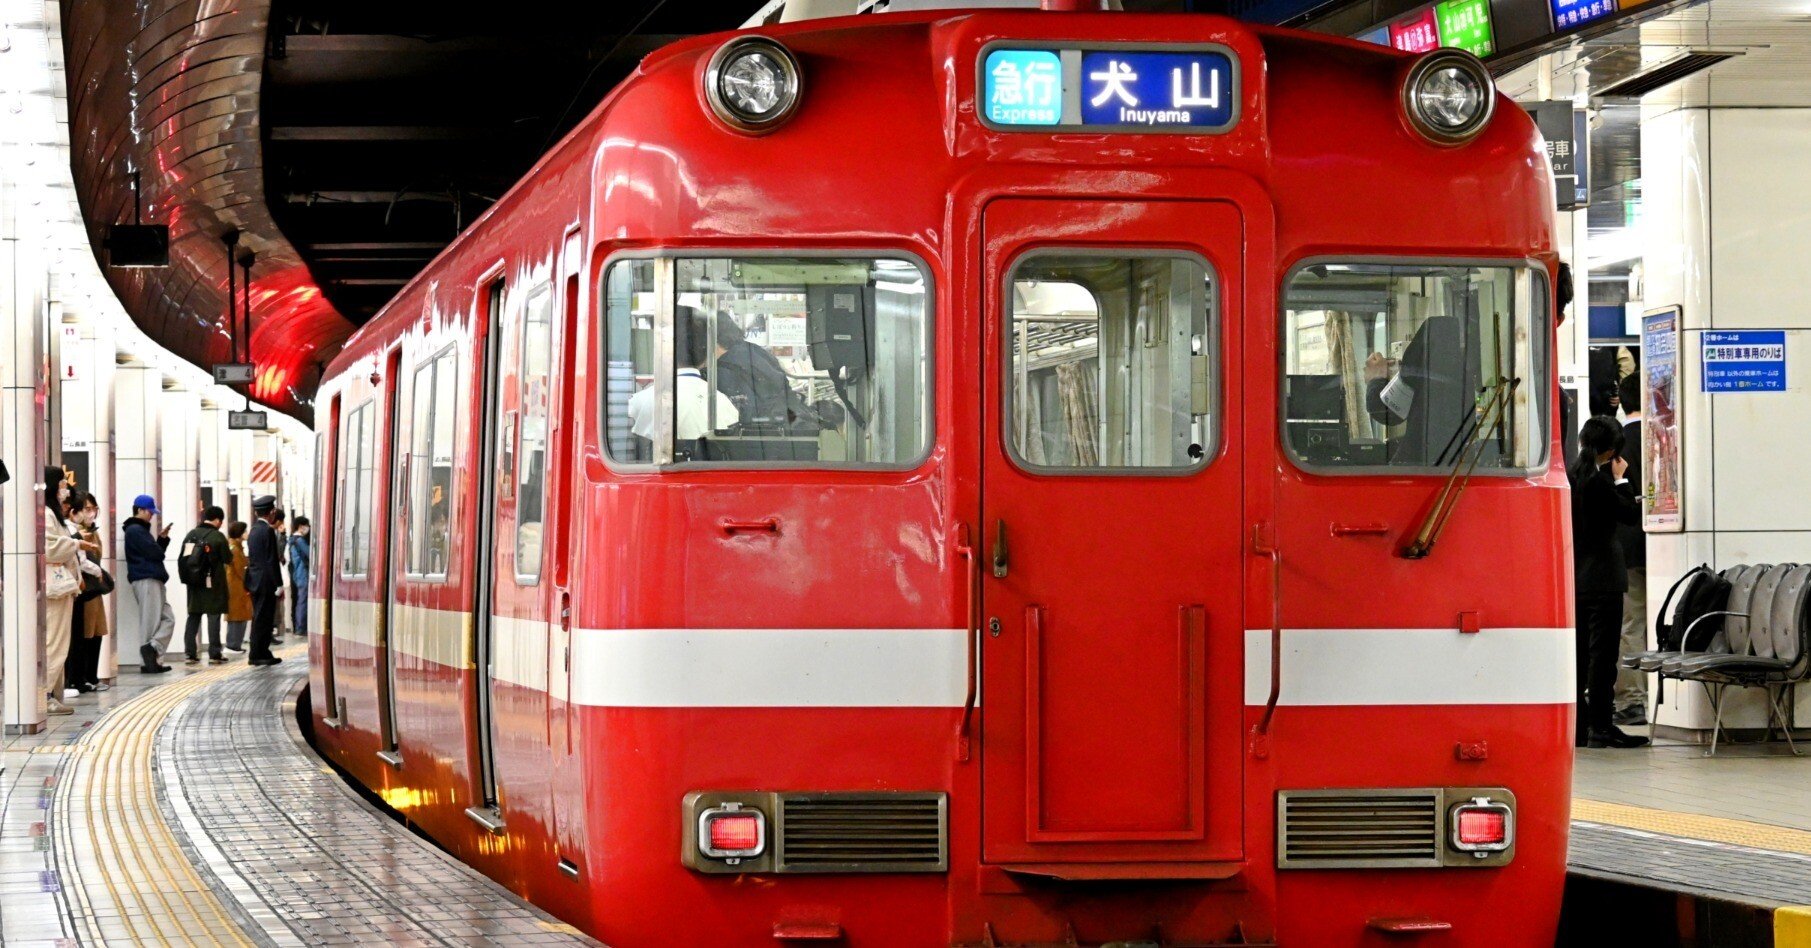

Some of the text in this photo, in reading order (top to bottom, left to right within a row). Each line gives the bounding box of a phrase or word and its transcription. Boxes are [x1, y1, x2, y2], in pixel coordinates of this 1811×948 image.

[992, 60, 1056, 105] 急行
[992, 106, 1055, 123] Express
[1120, 107, 1191, 124] Inuyama
[1552, 162, 1569, 171] ar
[1717, 347, 1782, 360] 特別車専用のりば
